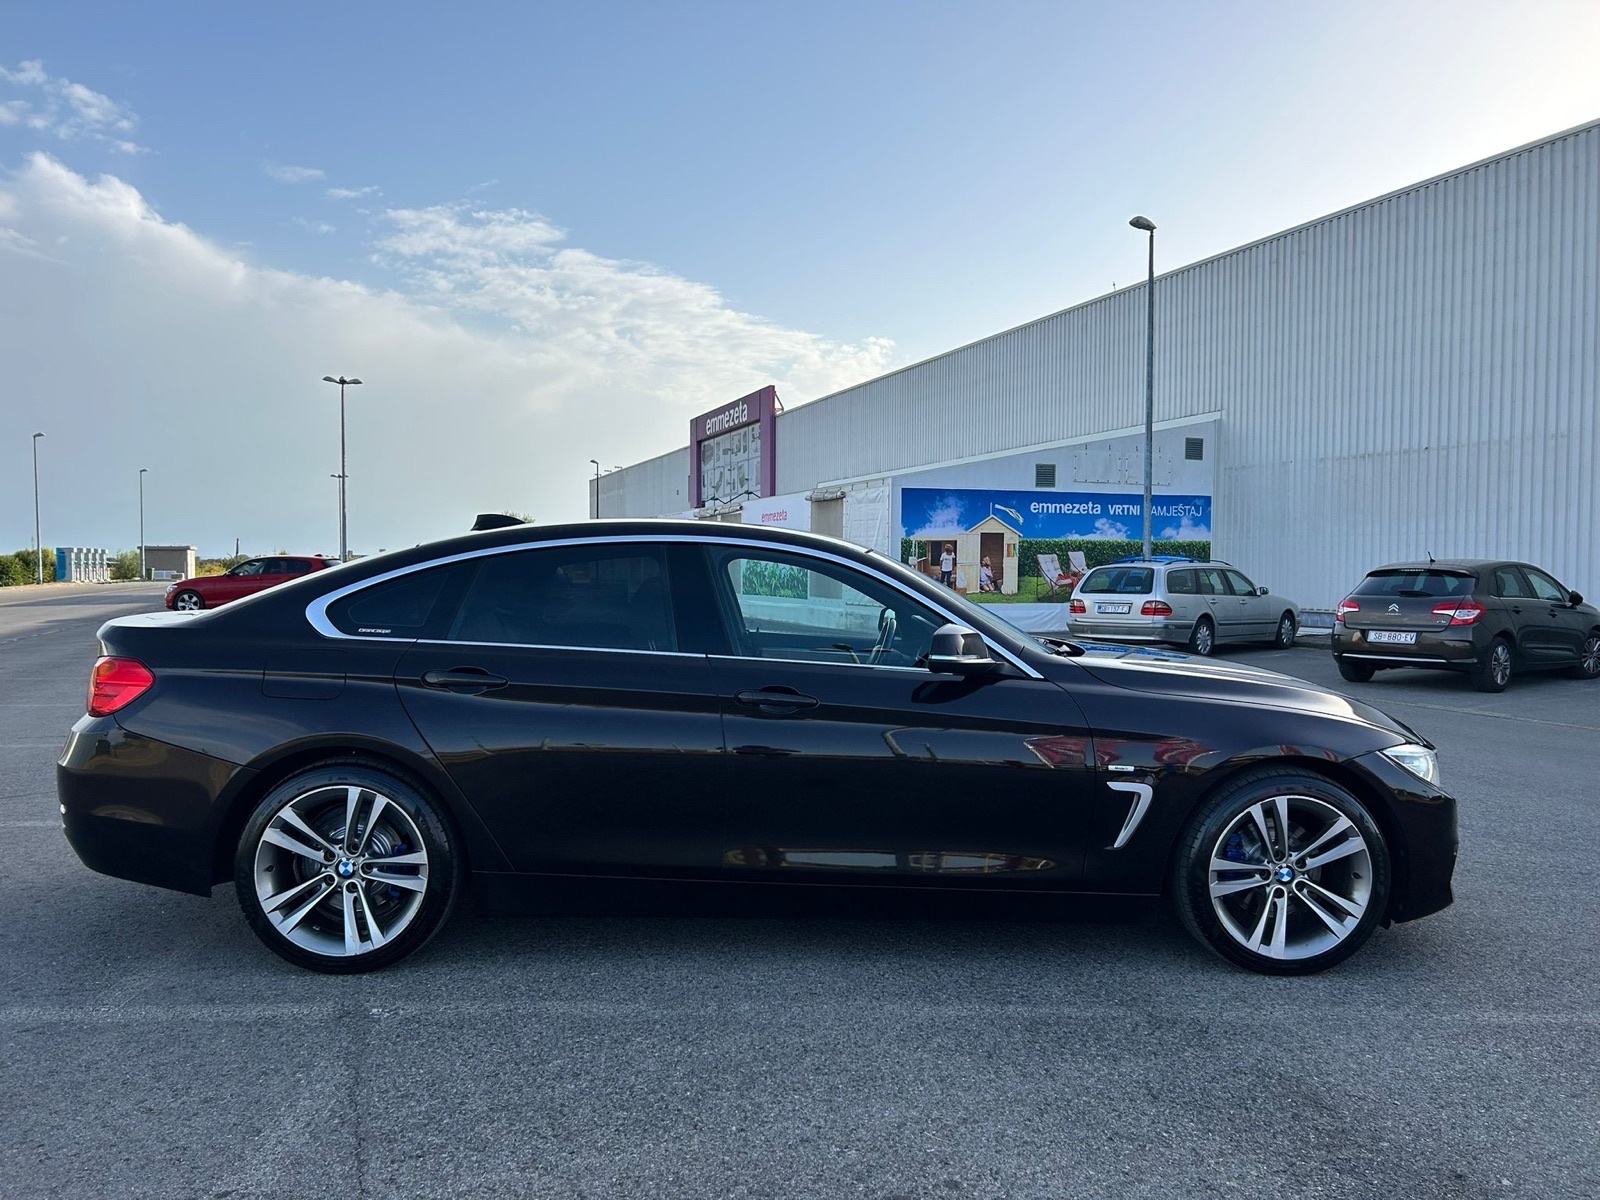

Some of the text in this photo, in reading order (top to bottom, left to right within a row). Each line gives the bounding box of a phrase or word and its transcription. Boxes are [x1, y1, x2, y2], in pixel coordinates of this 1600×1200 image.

[706, 400, 748, 435] emmezeta
[1030, 501, 1203, 517] emmezeta VRTNI AMJEŠTAJ
